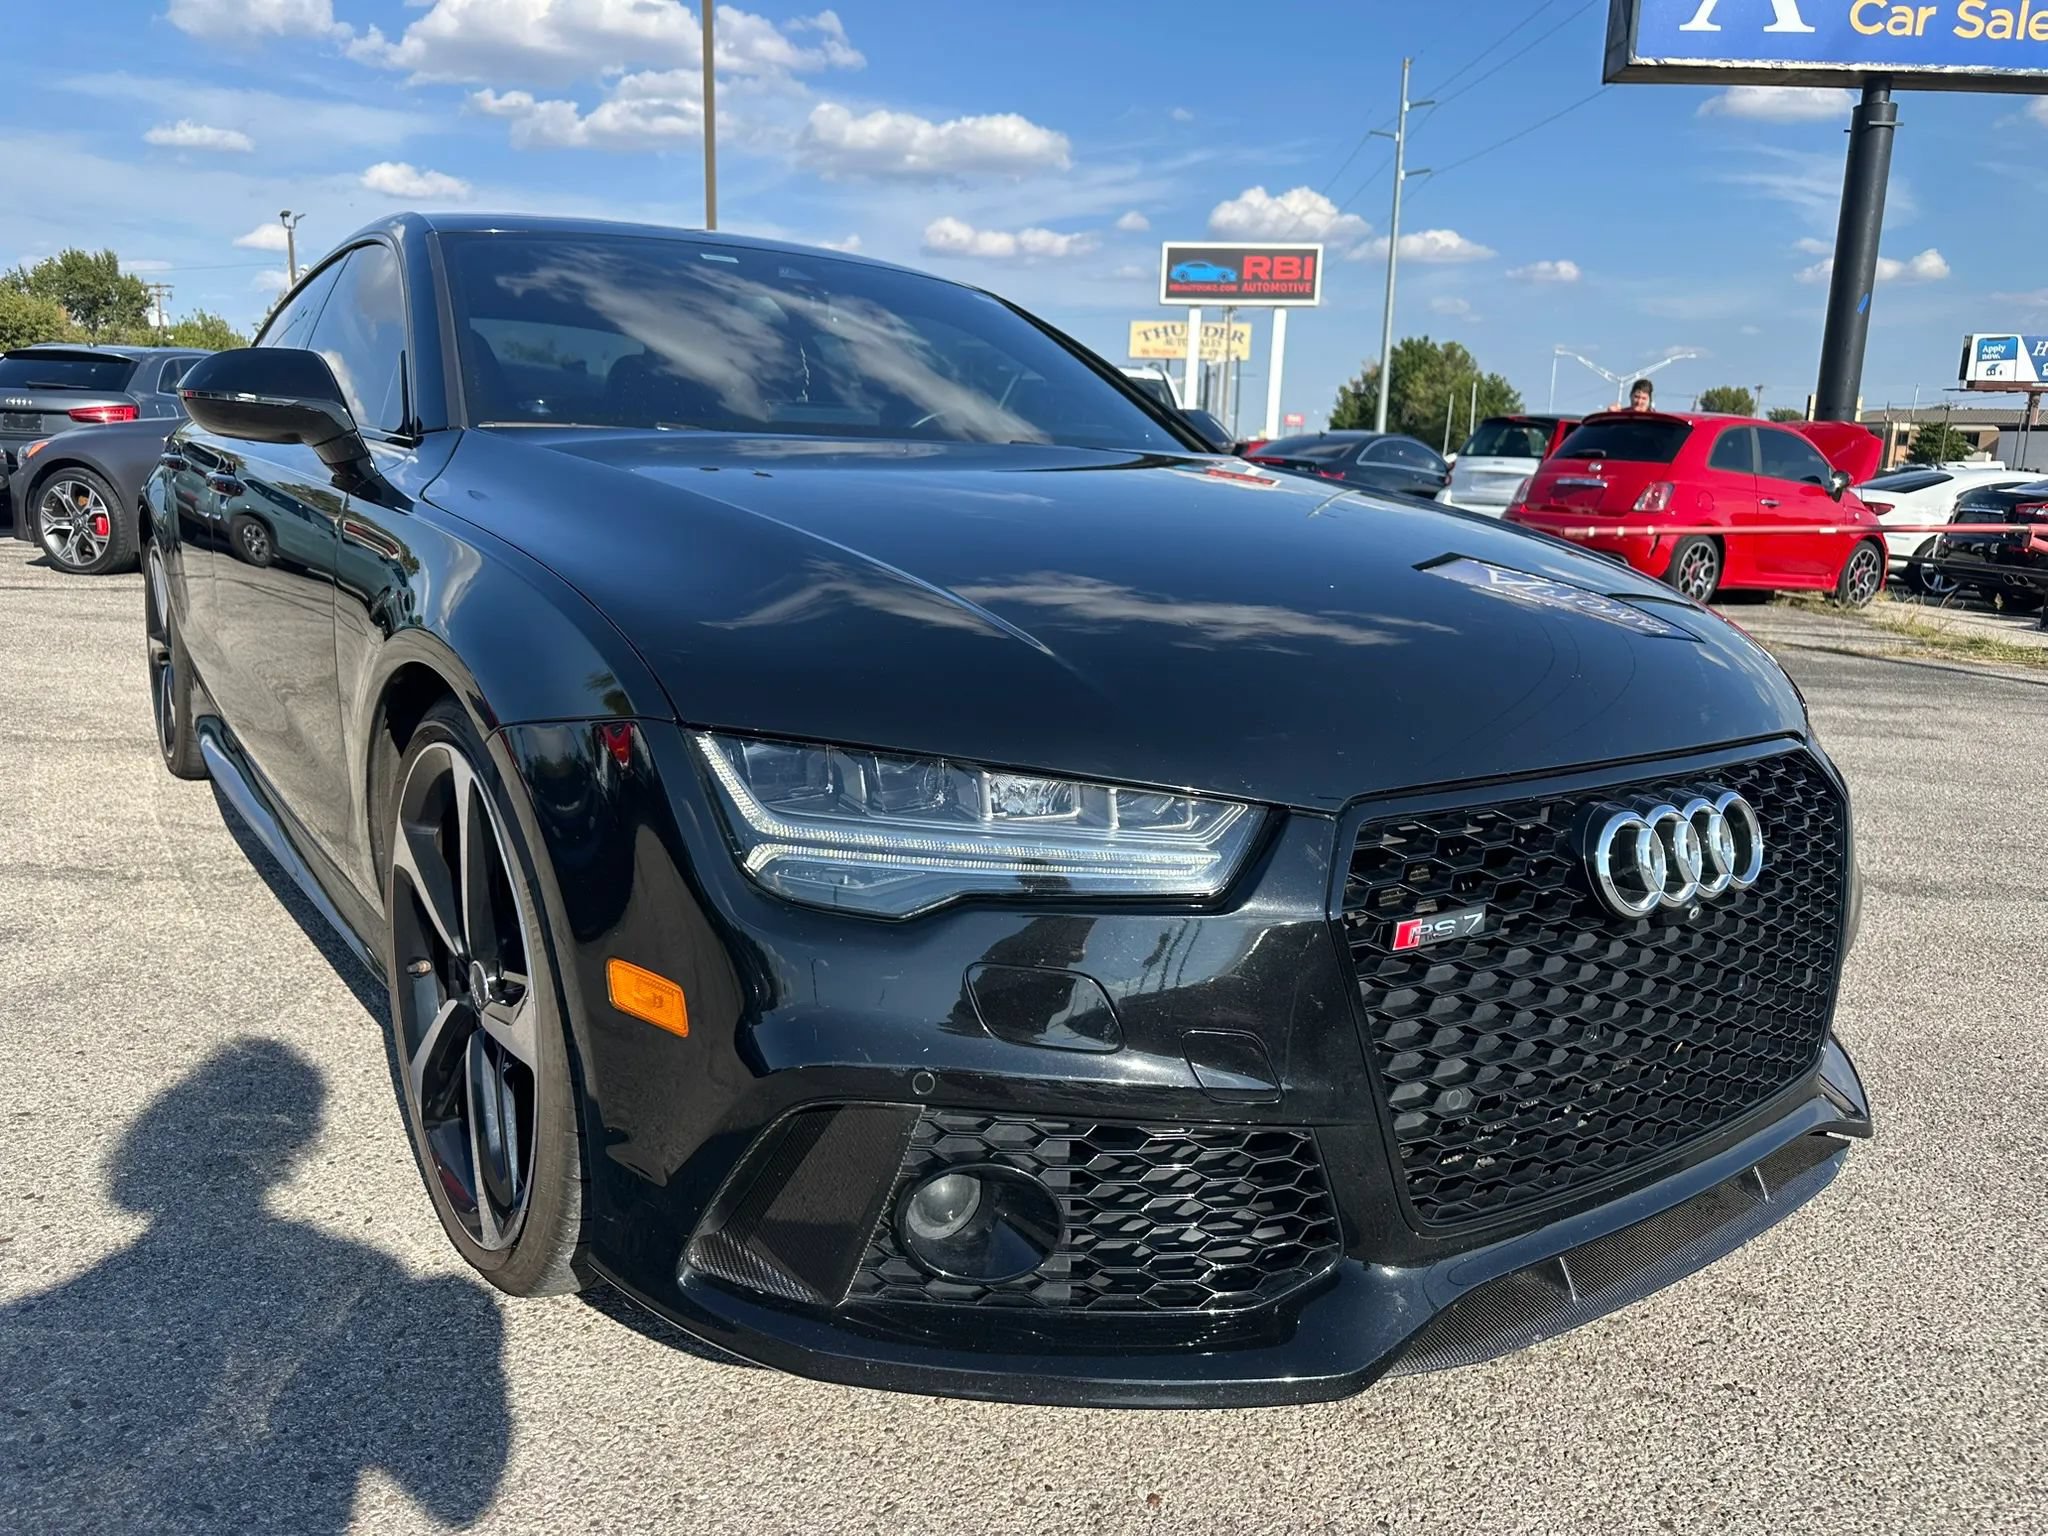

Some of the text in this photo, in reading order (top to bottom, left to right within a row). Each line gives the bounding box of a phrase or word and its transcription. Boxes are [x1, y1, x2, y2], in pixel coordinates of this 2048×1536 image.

[1849, 0, 1937, 36] Car
[1243, 256, 1314, 281] RBI
[1241, 281, 1311, 293] AUTOMOTIVE
[1136, 324, 1245, 344] THUDER
[1982, 344, 2006, 354] Apply
